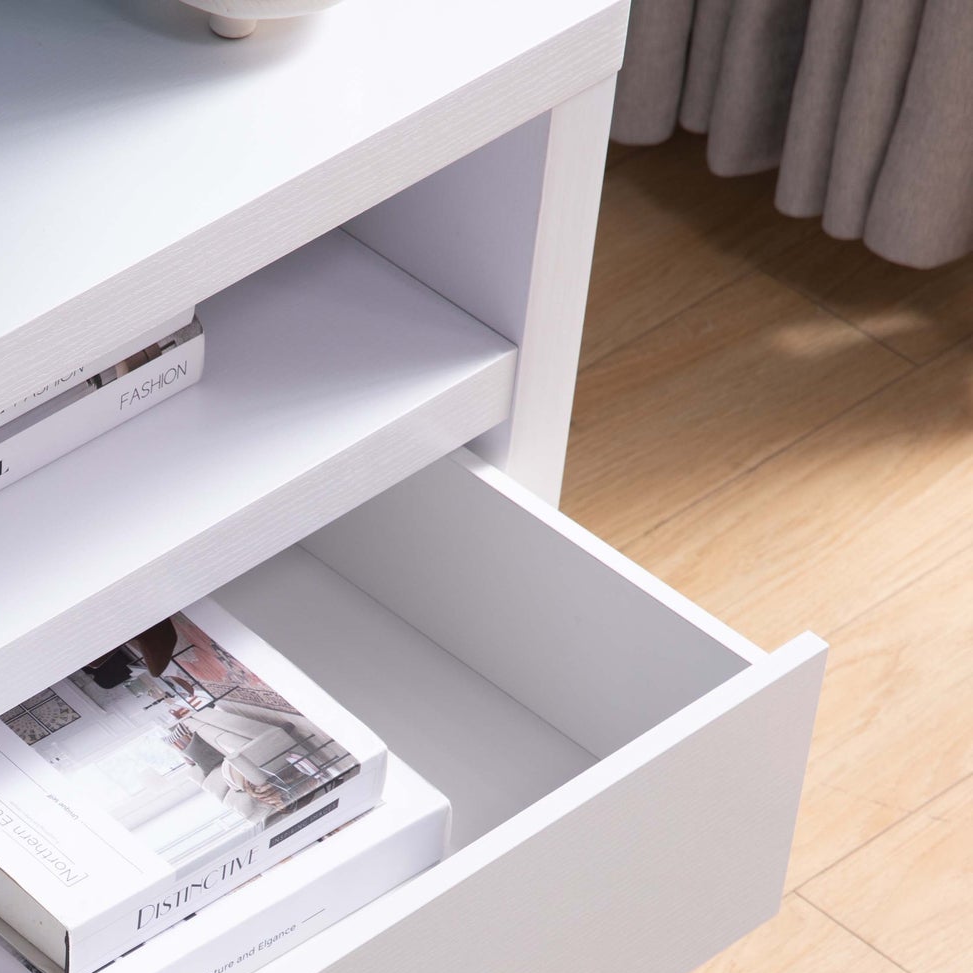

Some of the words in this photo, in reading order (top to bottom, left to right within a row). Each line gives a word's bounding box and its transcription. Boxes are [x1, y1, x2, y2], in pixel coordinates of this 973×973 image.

[119, 360, 188, 410] FASHION
[12, 824, 79, 883] Northern
[136, 844, 260, 930] DISTINCTIVE
[236, 946, 256, 964] and
[258, 924, 297, 951] Elgance
